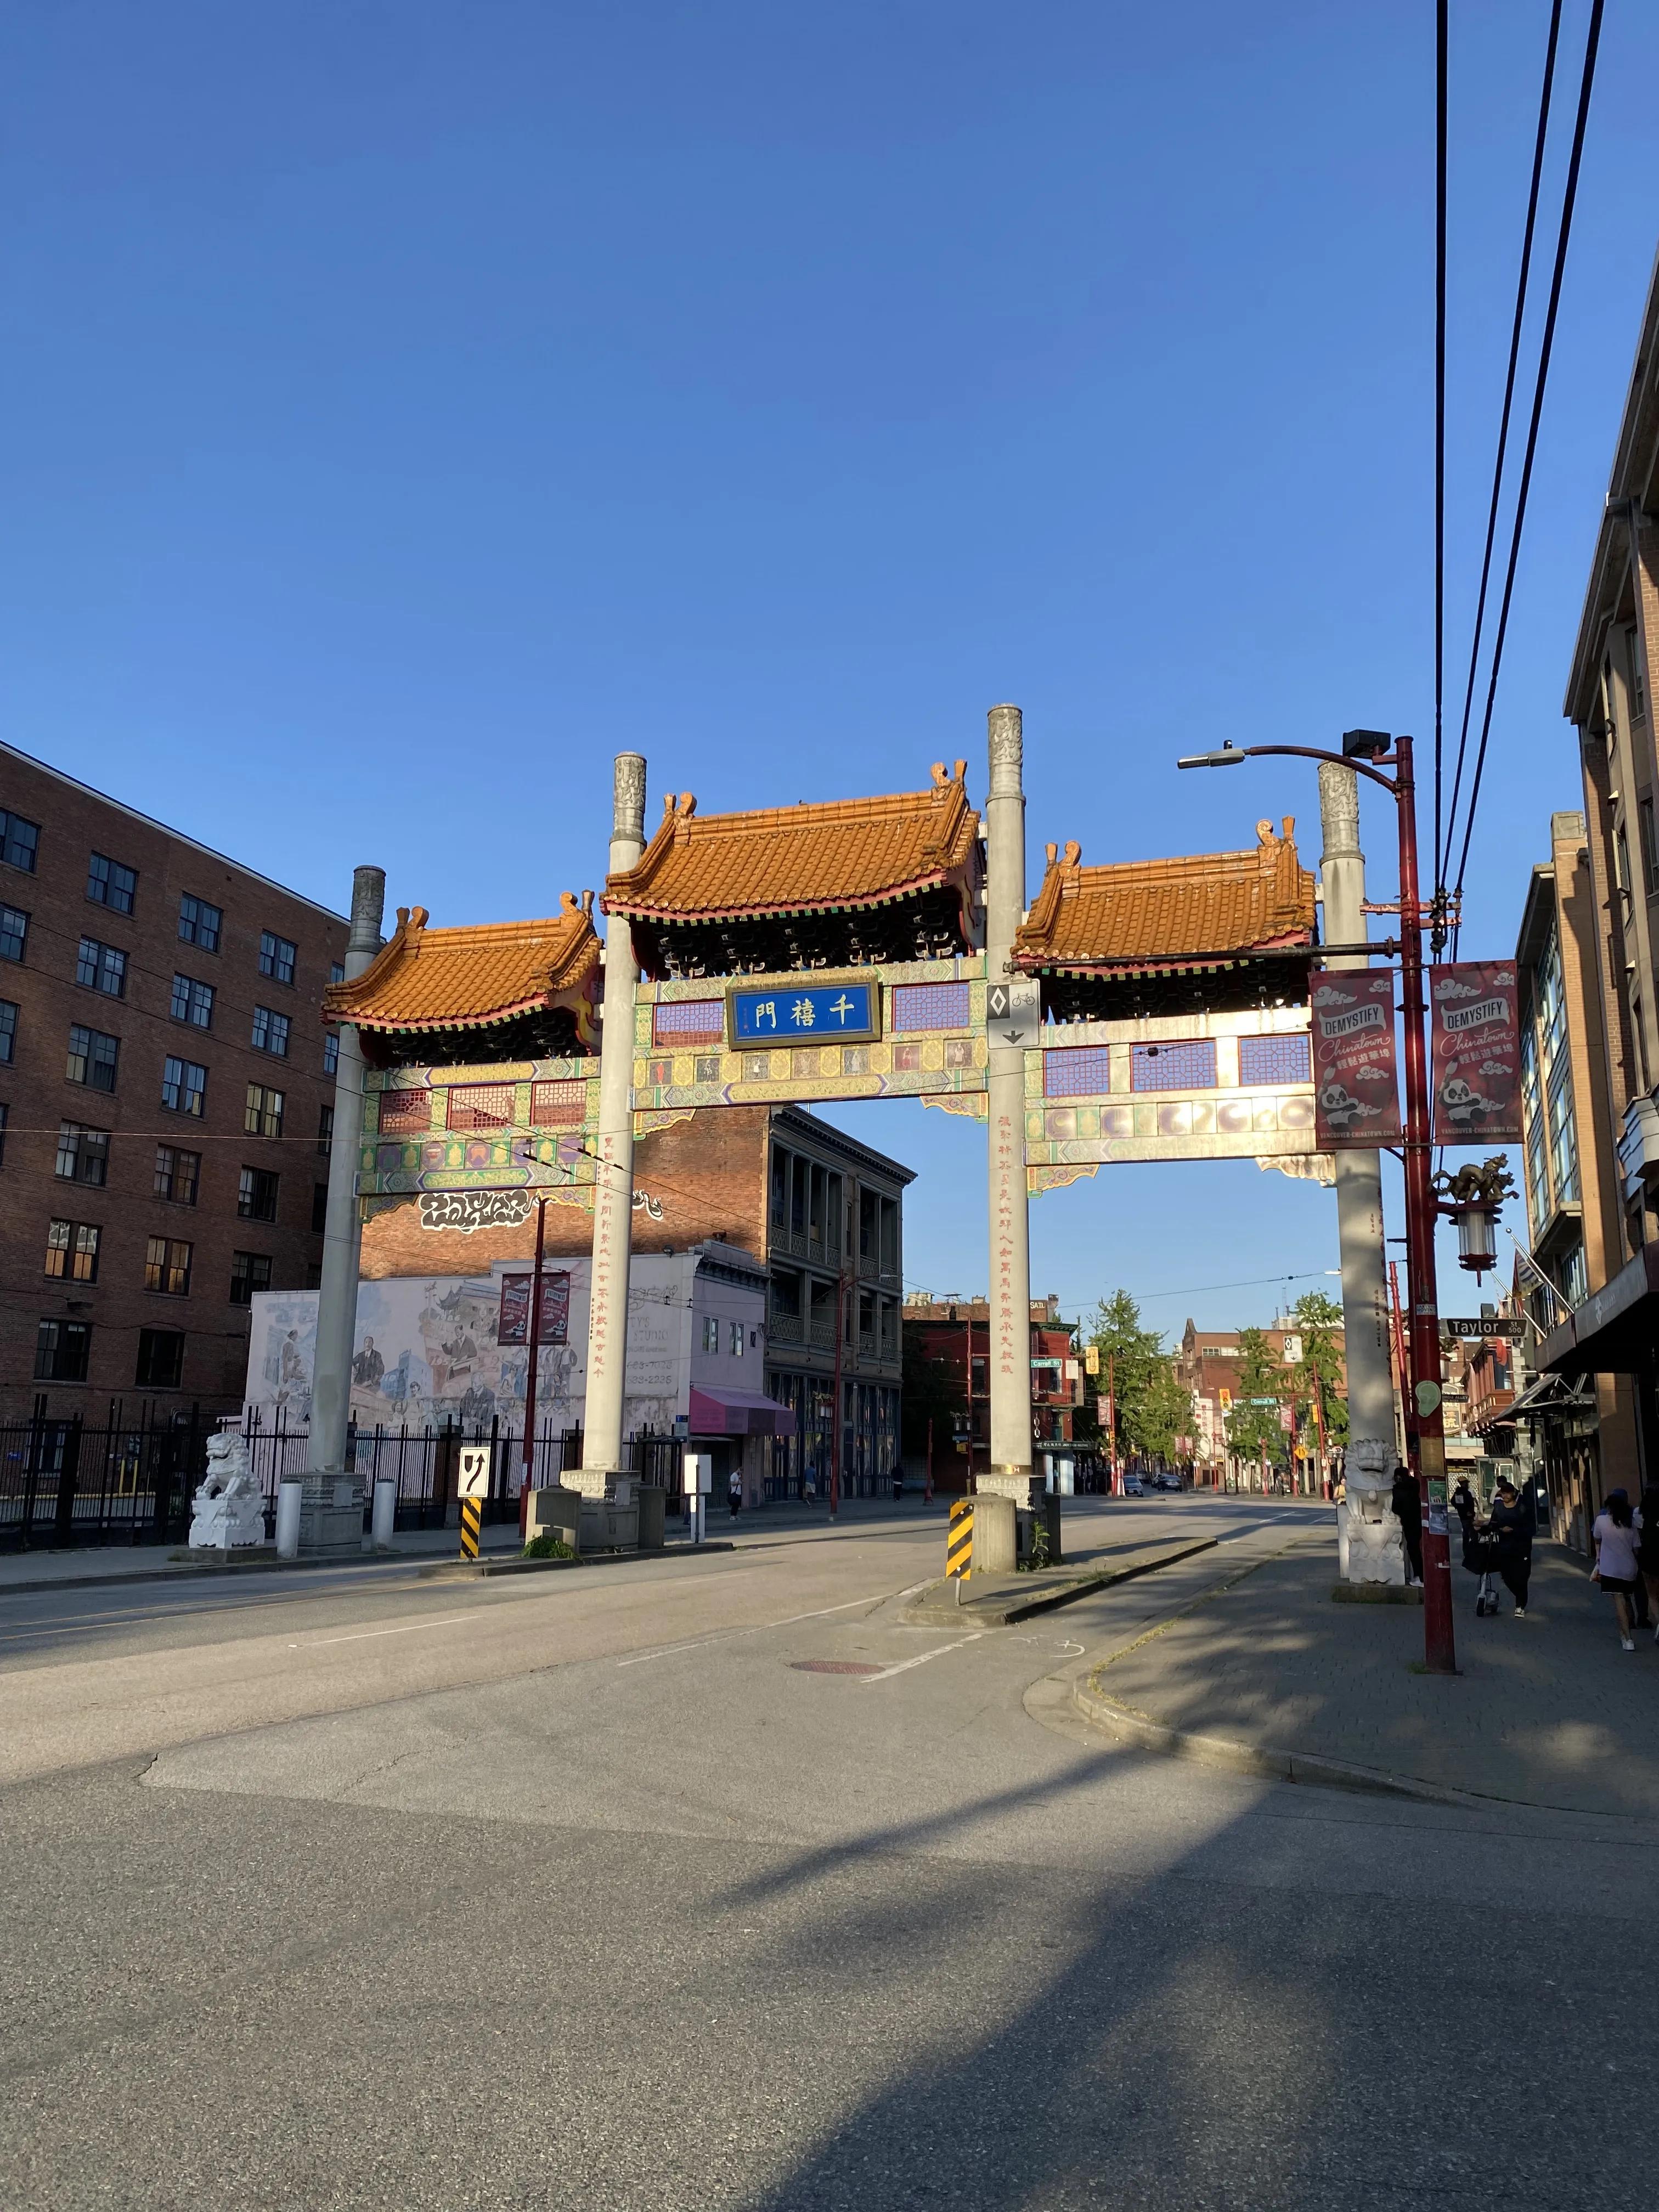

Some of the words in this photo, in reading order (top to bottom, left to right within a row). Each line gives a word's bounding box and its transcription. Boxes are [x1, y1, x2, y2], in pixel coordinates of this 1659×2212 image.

[1325, 1007, 1379, 1035] DEMYSTIFY
[1448, 1001, 1502, 1029] DEMYSTIFY
[1318, 1032, 1391, 1062] Chinatown
[1440, 1027, 1515, 1056] Chinatown
[1453, 1321, 1499, 1336] Taylor
